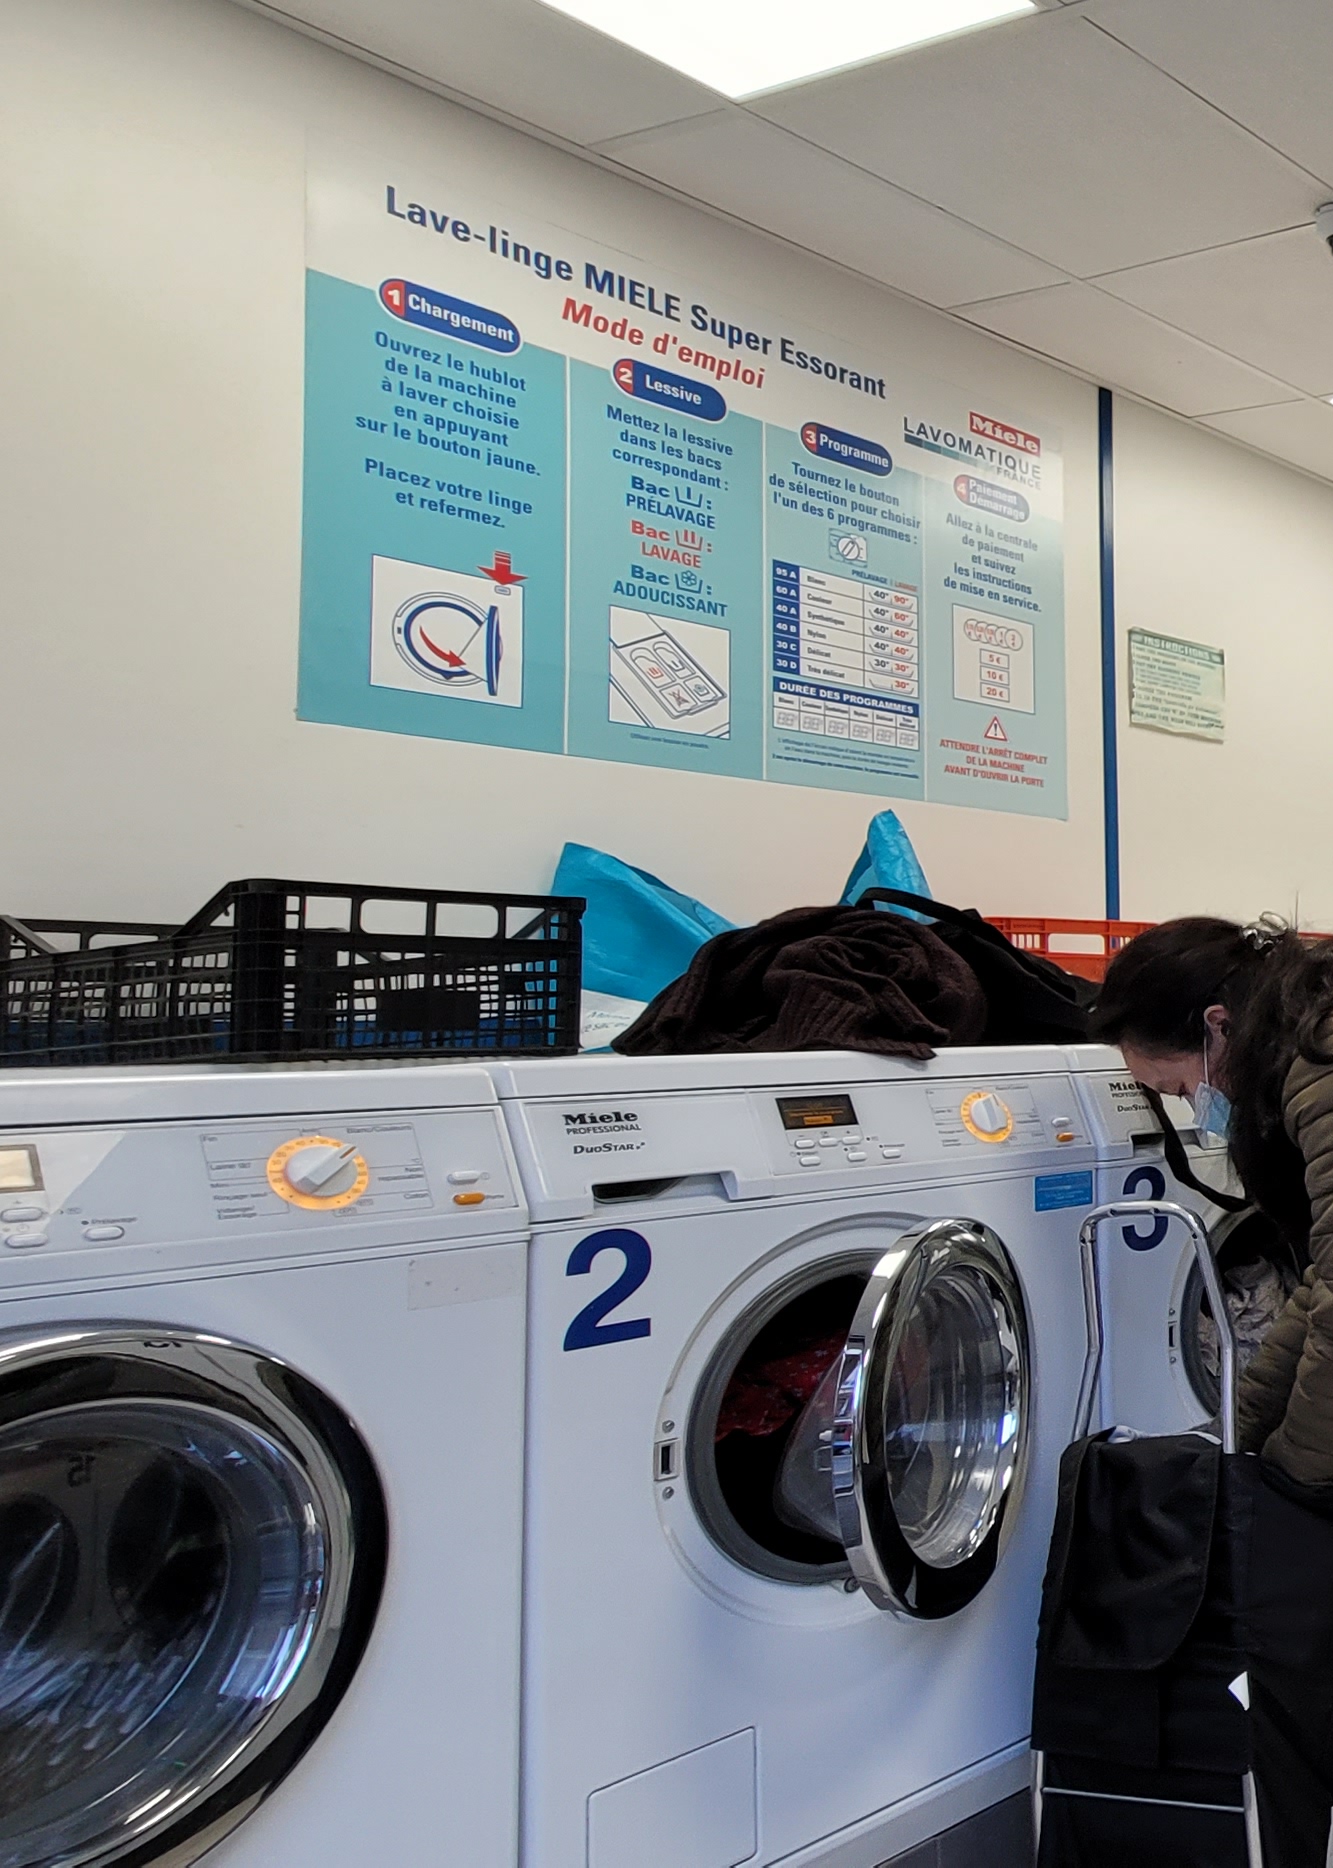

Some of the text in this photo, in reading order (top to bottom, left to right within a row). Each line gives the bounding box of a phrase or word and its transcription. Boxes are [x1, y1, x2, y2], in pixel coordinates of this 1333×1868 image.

[385, 185, 886, 399] Lave-linge MIELE Super Essorant
[387, 289, 515, 343] 1 Chargement
[375, 331, 526, 392] Ouvrez le hublot
[562, 297, 765, 388] Mode d'emploi
[382, 377, 520, 430] à laver choisie
[385, 357, 516, 408] de la machine
[619, 367, 702, 405] 2 Lessive
[356, 414, 541, 476] sur le bouton jaune.
[394, 405, 508, 449] en appuyant
[607, 404, 733, 455] Mettez la lessive
[806, 431, 888, 468] 3 Programme
[904, 416, 1041, 480] LAVOMATIQUE
[971, 414, 1040, 452] Miele
[365, 458, 533, 514] Placez votre linge
[396, 492, 505, 528] et refermez.
[626, 493, 715, 529] PRÉLAVAGE
[642, 542, 702, 568] LAVAGE
[613, 581, 728, 617] ADOUCISSANT
[820, 688, 840, 700] DES
[843, 693, 914, 714] PROGRAMMES
[562, 1111, 638, 1125] Miele
[566, 1123, 642, 1135] PROFESSIONAL
[1122, 1166, 1169, 1252] 3
[563, 1228, 652, 1352] 2
